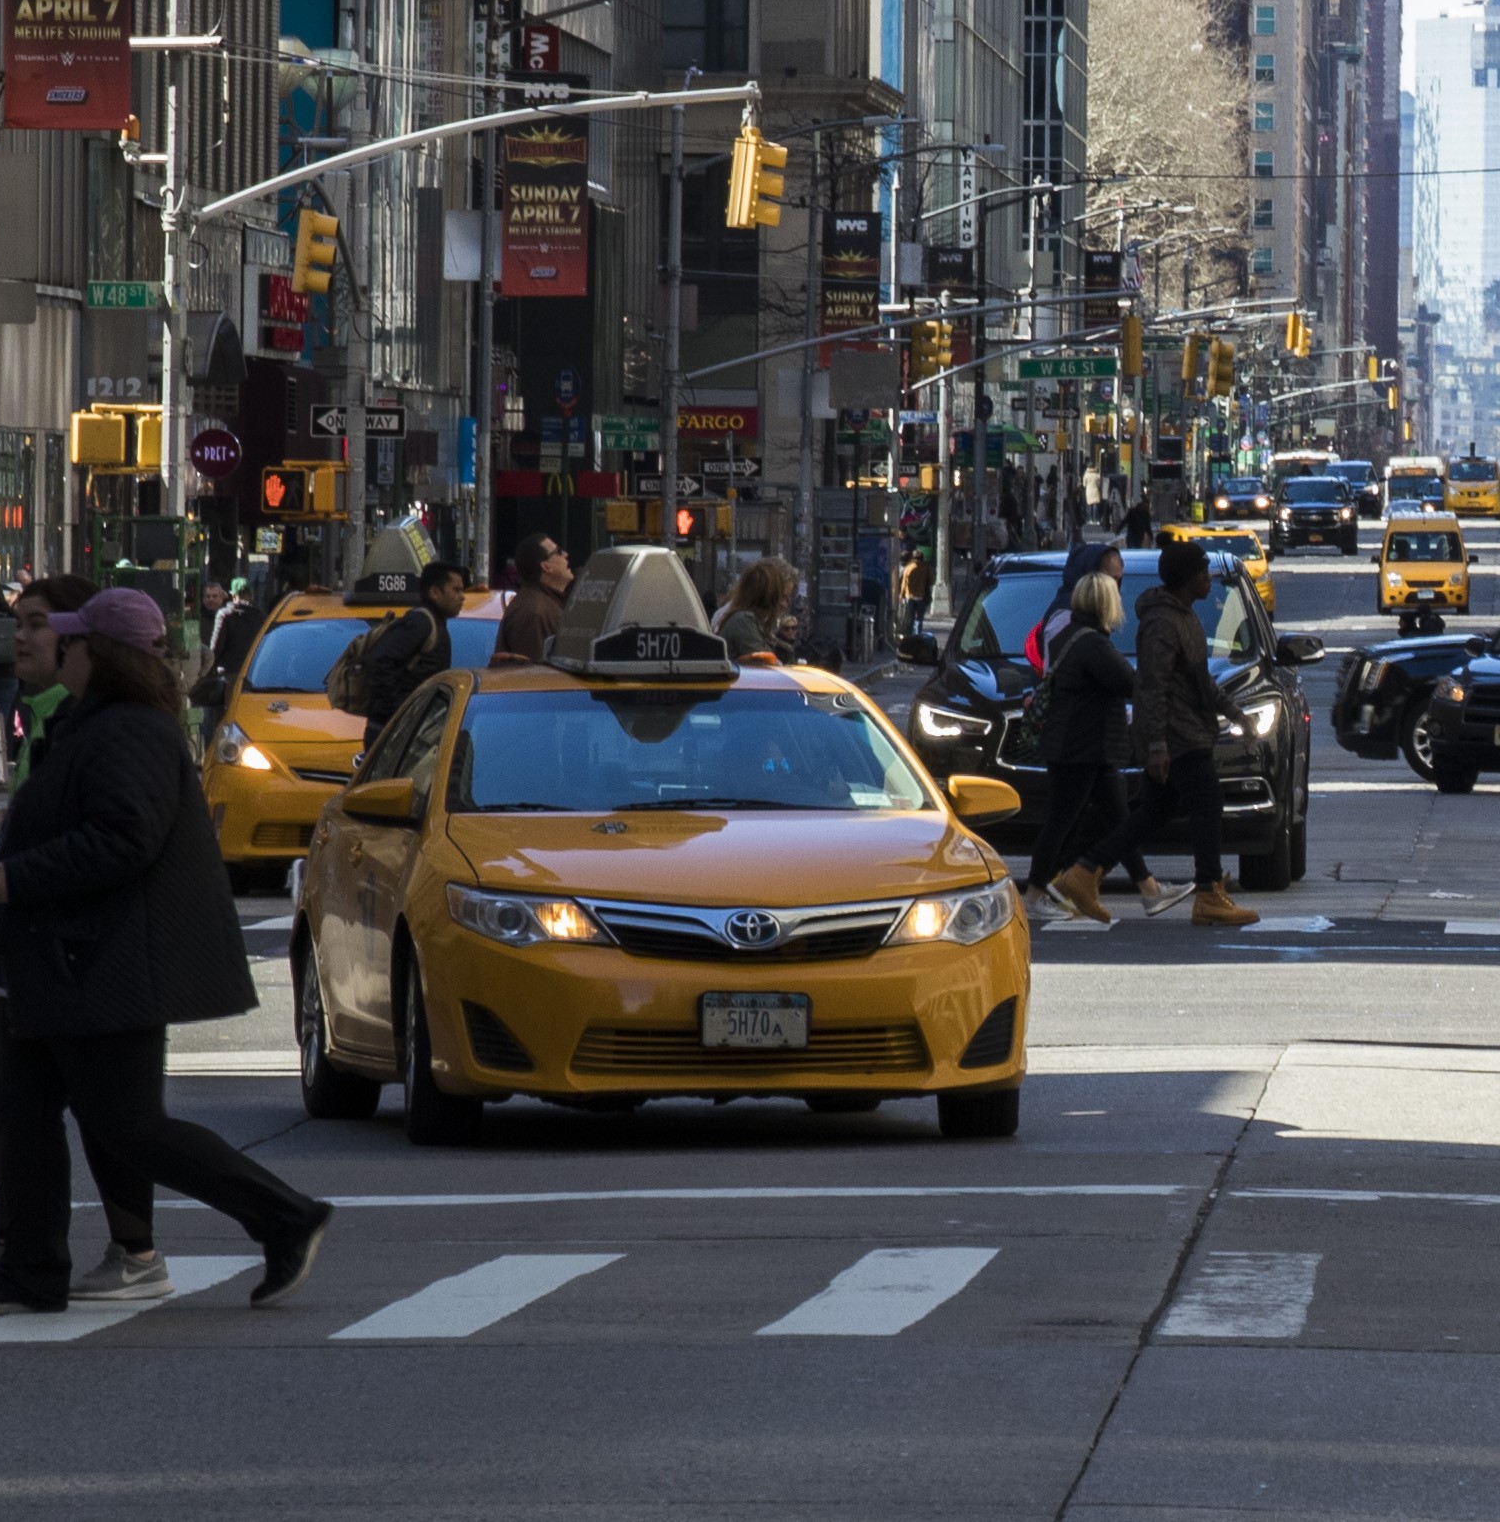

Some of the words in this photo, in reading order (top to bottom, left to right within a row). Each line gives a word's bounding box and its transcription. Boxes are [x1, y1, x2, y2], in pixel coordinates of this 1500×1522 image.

[14, 26, 64, 40] METLIFE
[68, 26, 121, 40] STADIUM
[510, 185, 580, 202] SUNDAY
[510, 204, 564, 223] APRIL
[569, 205, 580, 223] 7
[836, 219, 868, 232] NYC
[93, 286, 104, 305] W
[107, 286, 127, 304] 48
[130, 285, 143, 296] ST
[826, 291, 875, 303] SUNDAY
[826, 304, 862, 316] APRIL
[868, 304, 875, 316] 7
[1041, 363, 1053, 374] W
[1060, 362, 1076, 373] 46
[1083, 362, 1095, 374] St
[87, 377, 142, 397] 1212
[326, 415, 347, 427] ON
[366, 416, 393, 428] WAY
[677, 414, 744, 429] FARGO
[606, 434, 615, 447] W
[621, 434, 636, 447] 47
[204, 447, 227, 461] PRET
[708, 464, 725, 472] ONE
[735, 463, 754, 473] WAY
[378, 575, 406, 592] 5G86
[637, 633, 681, 659] 5H70
